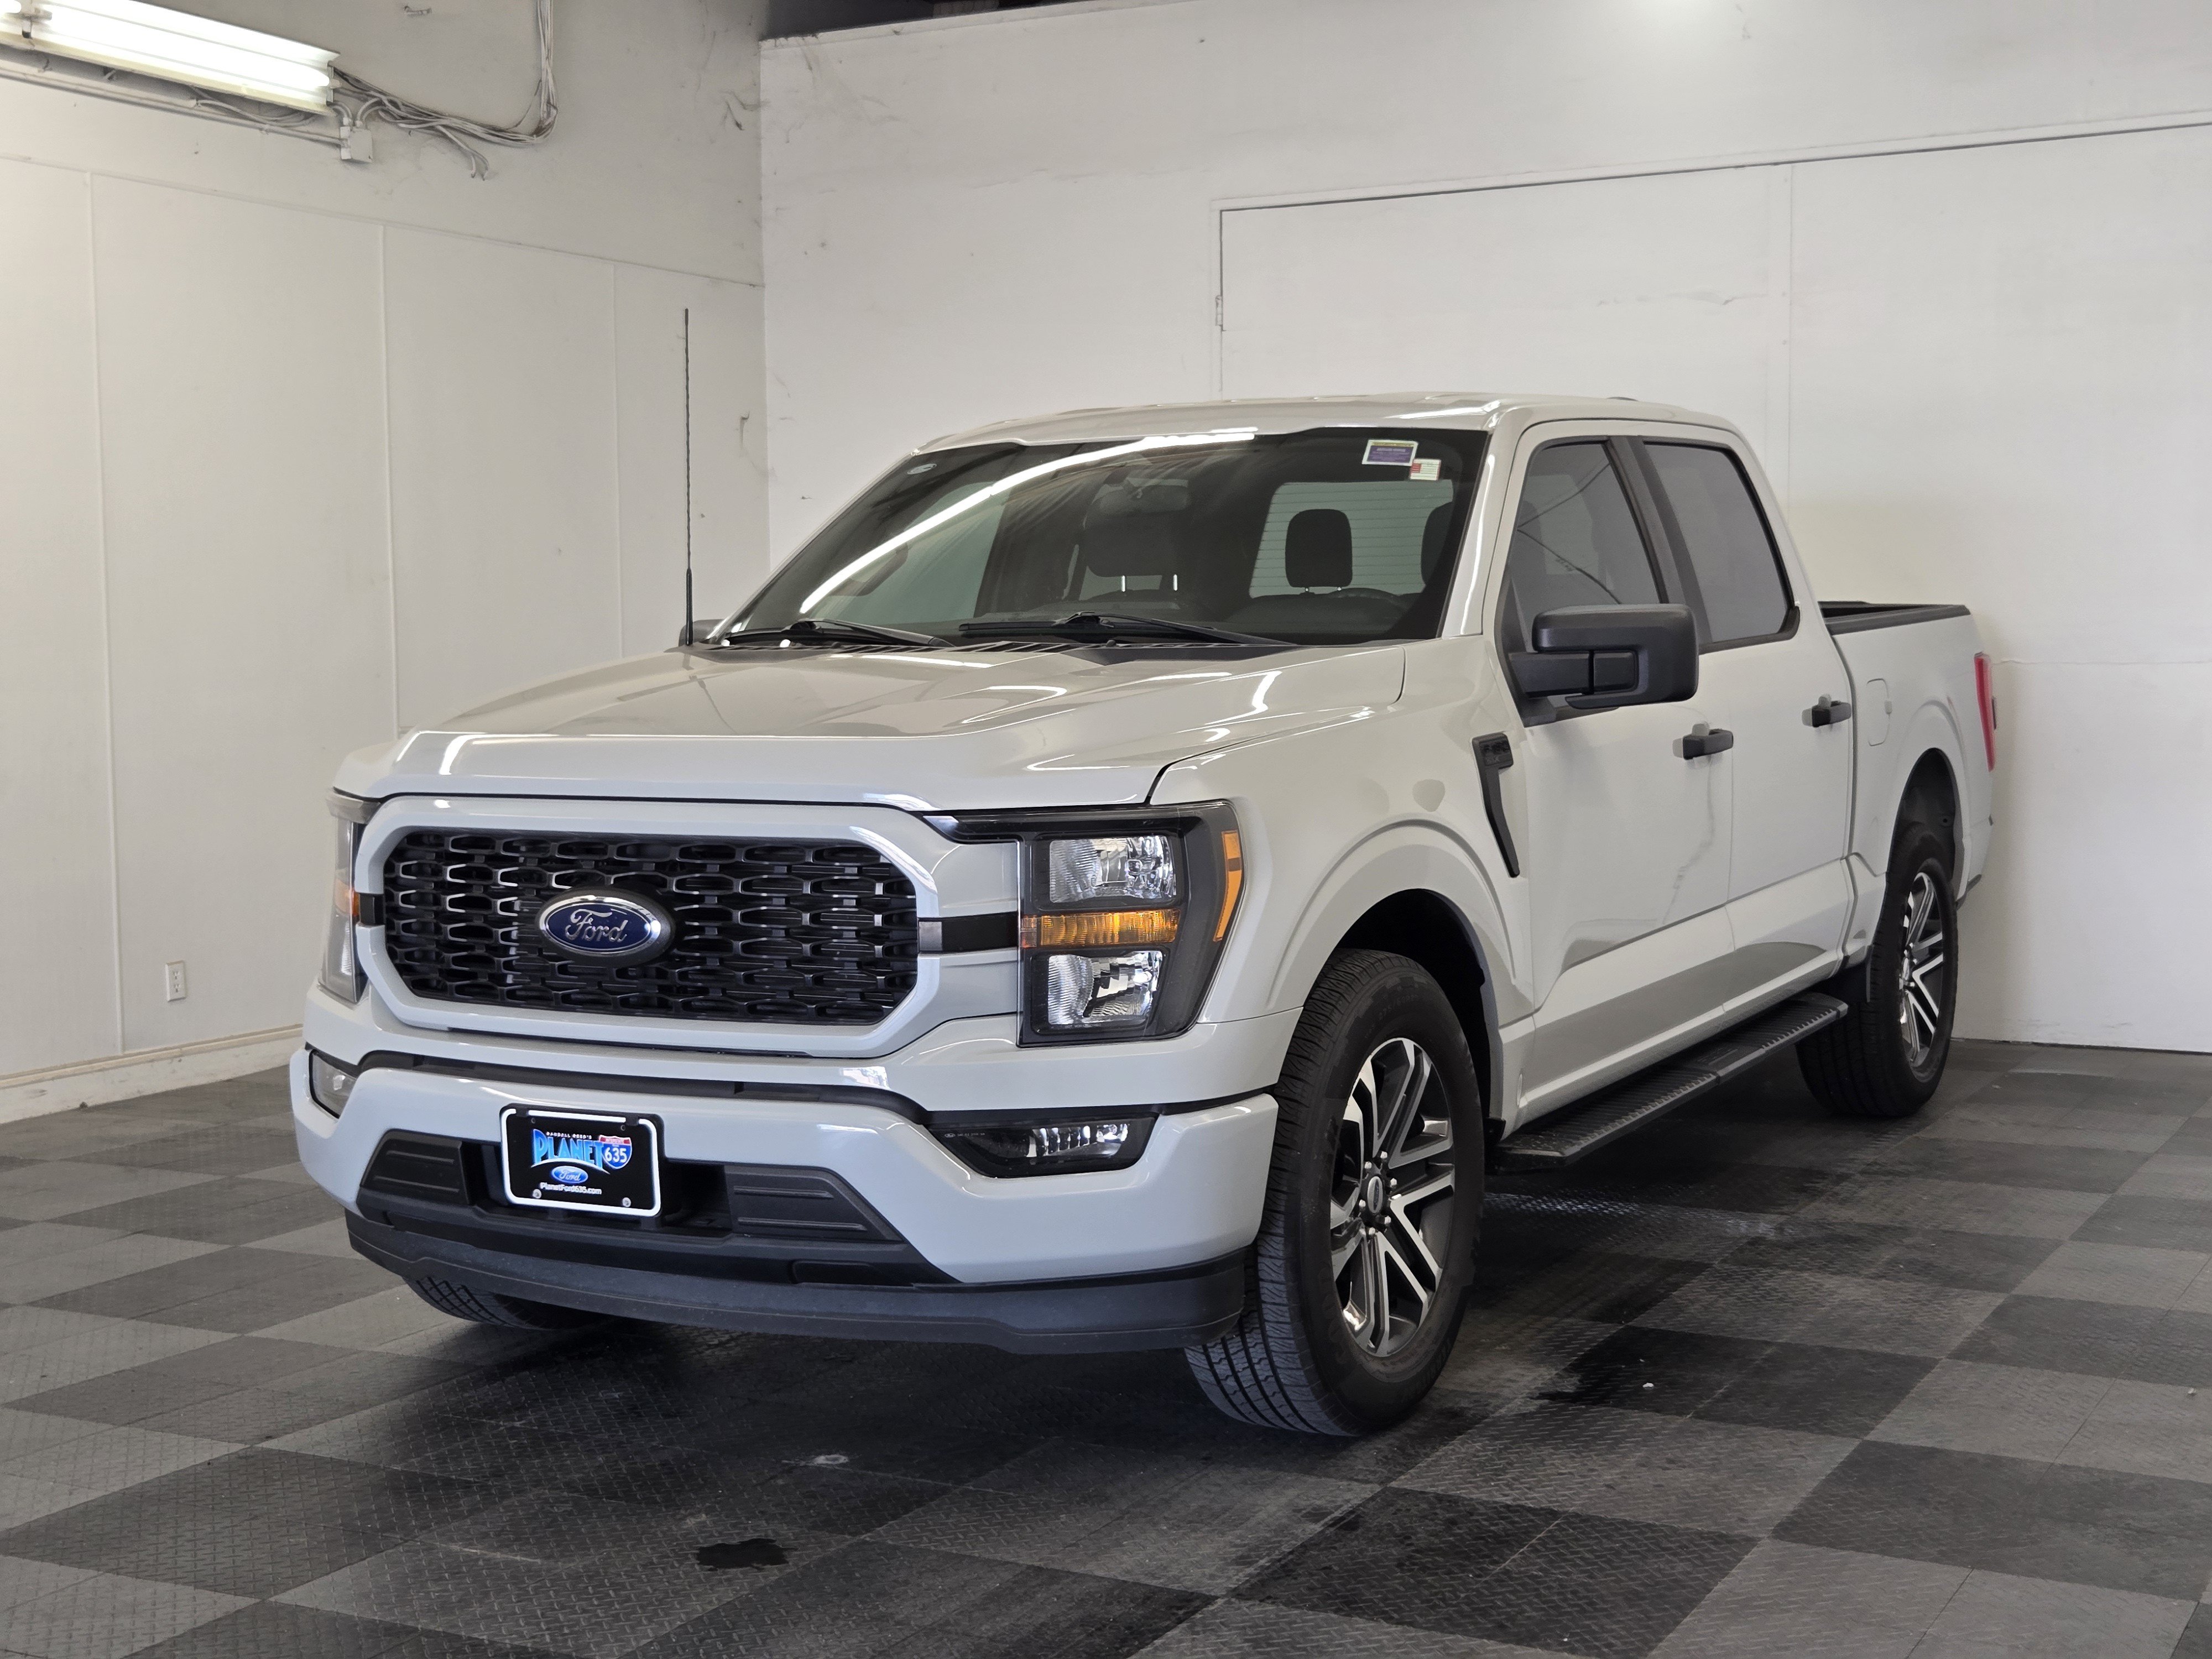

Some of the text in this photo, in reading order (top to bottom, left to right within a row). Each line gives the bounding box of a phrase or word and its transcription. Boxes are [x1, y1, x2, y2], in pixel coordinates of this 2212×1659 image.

[565, 909, 628, 943] Ford
[533, 1129, 603, 1169] PLANET
[604, 1147, 628, 1163] 635
[559, 1169, 581, 1182] Ford
